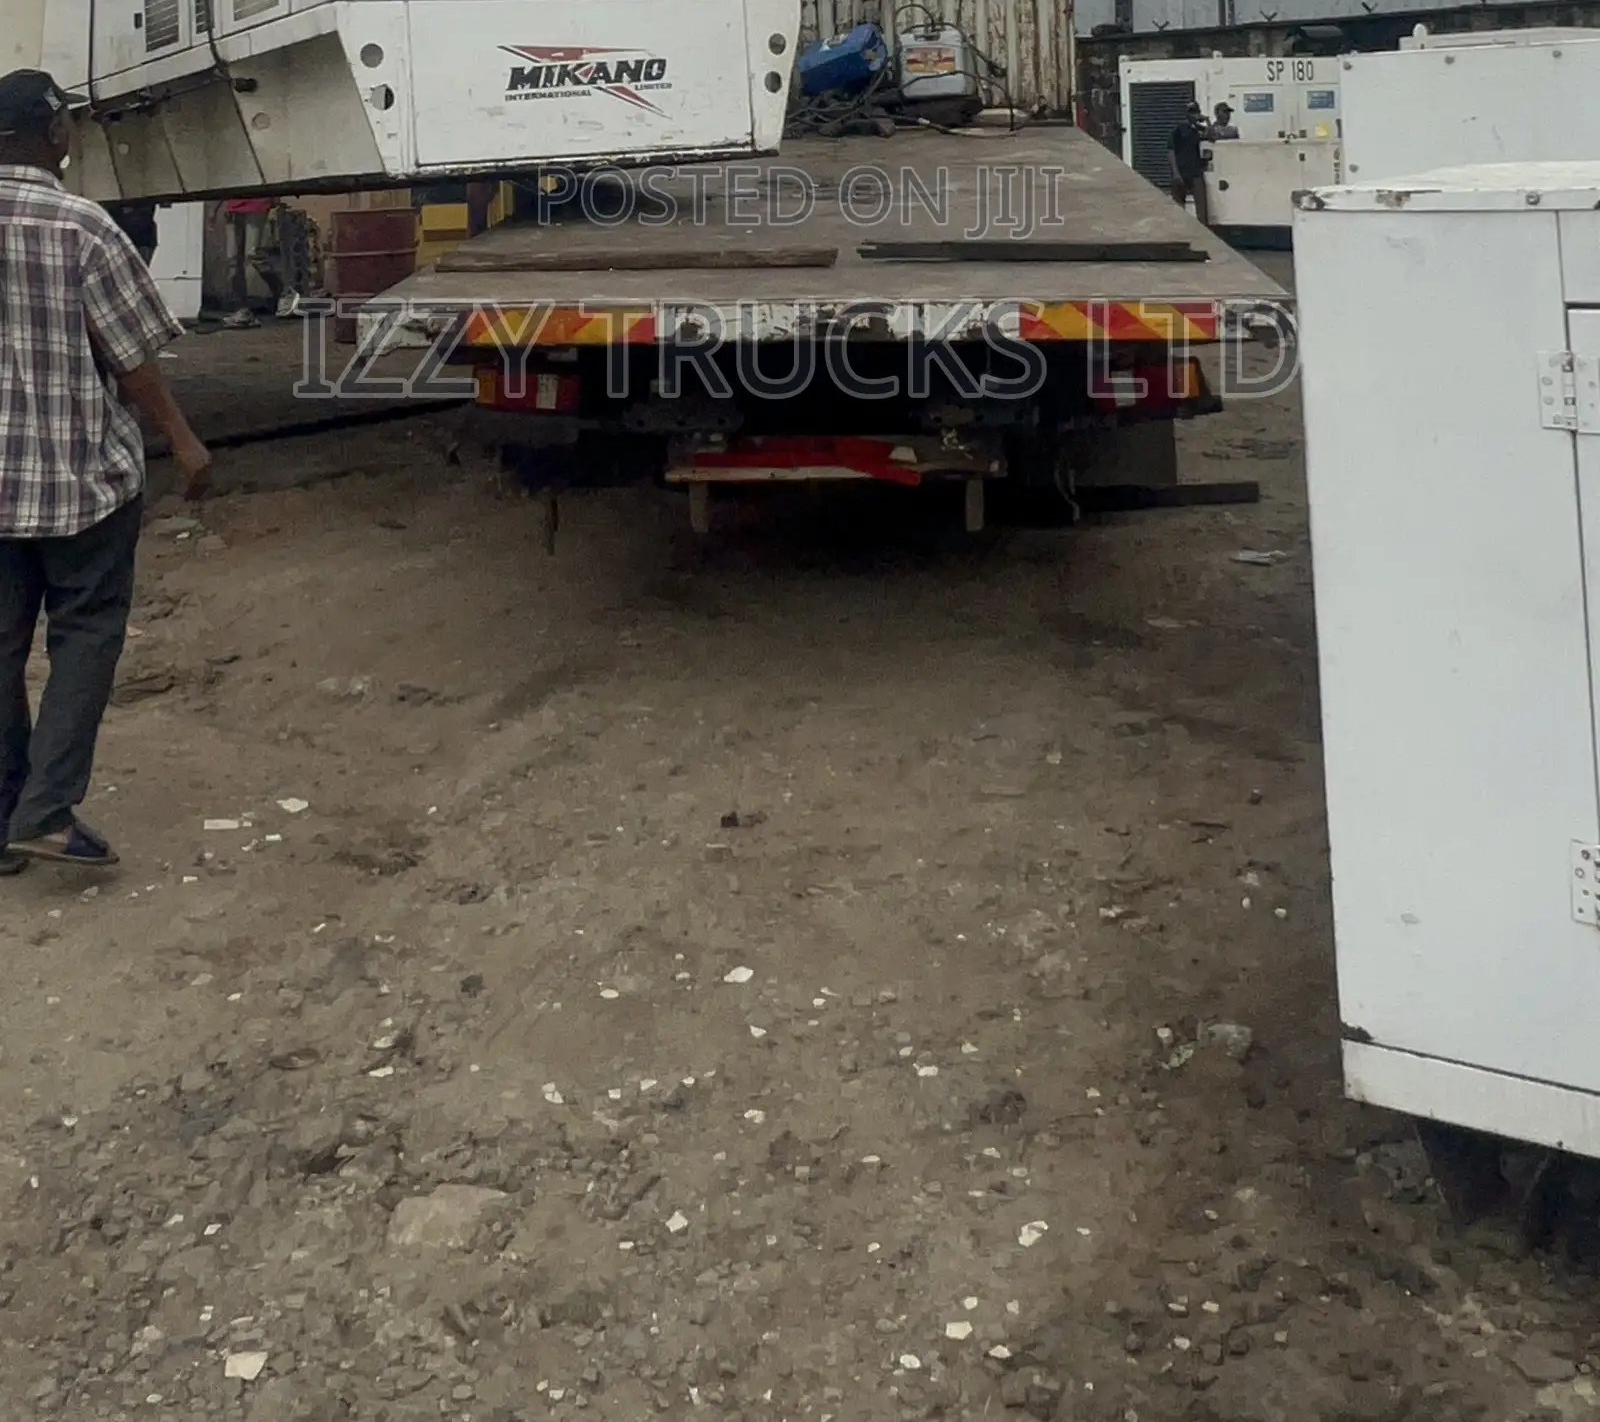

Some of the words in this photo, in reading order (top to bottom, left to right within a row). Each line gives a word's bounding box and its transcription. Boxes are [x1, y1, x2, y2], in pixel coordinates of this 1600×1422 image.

[506, 58, 667, 90] MIKANO
[1266, 61, 1284, 81] SP
[1291, 60, 1314, 81] 180
[504, 89, 592, 102] INTERNATIONAL
